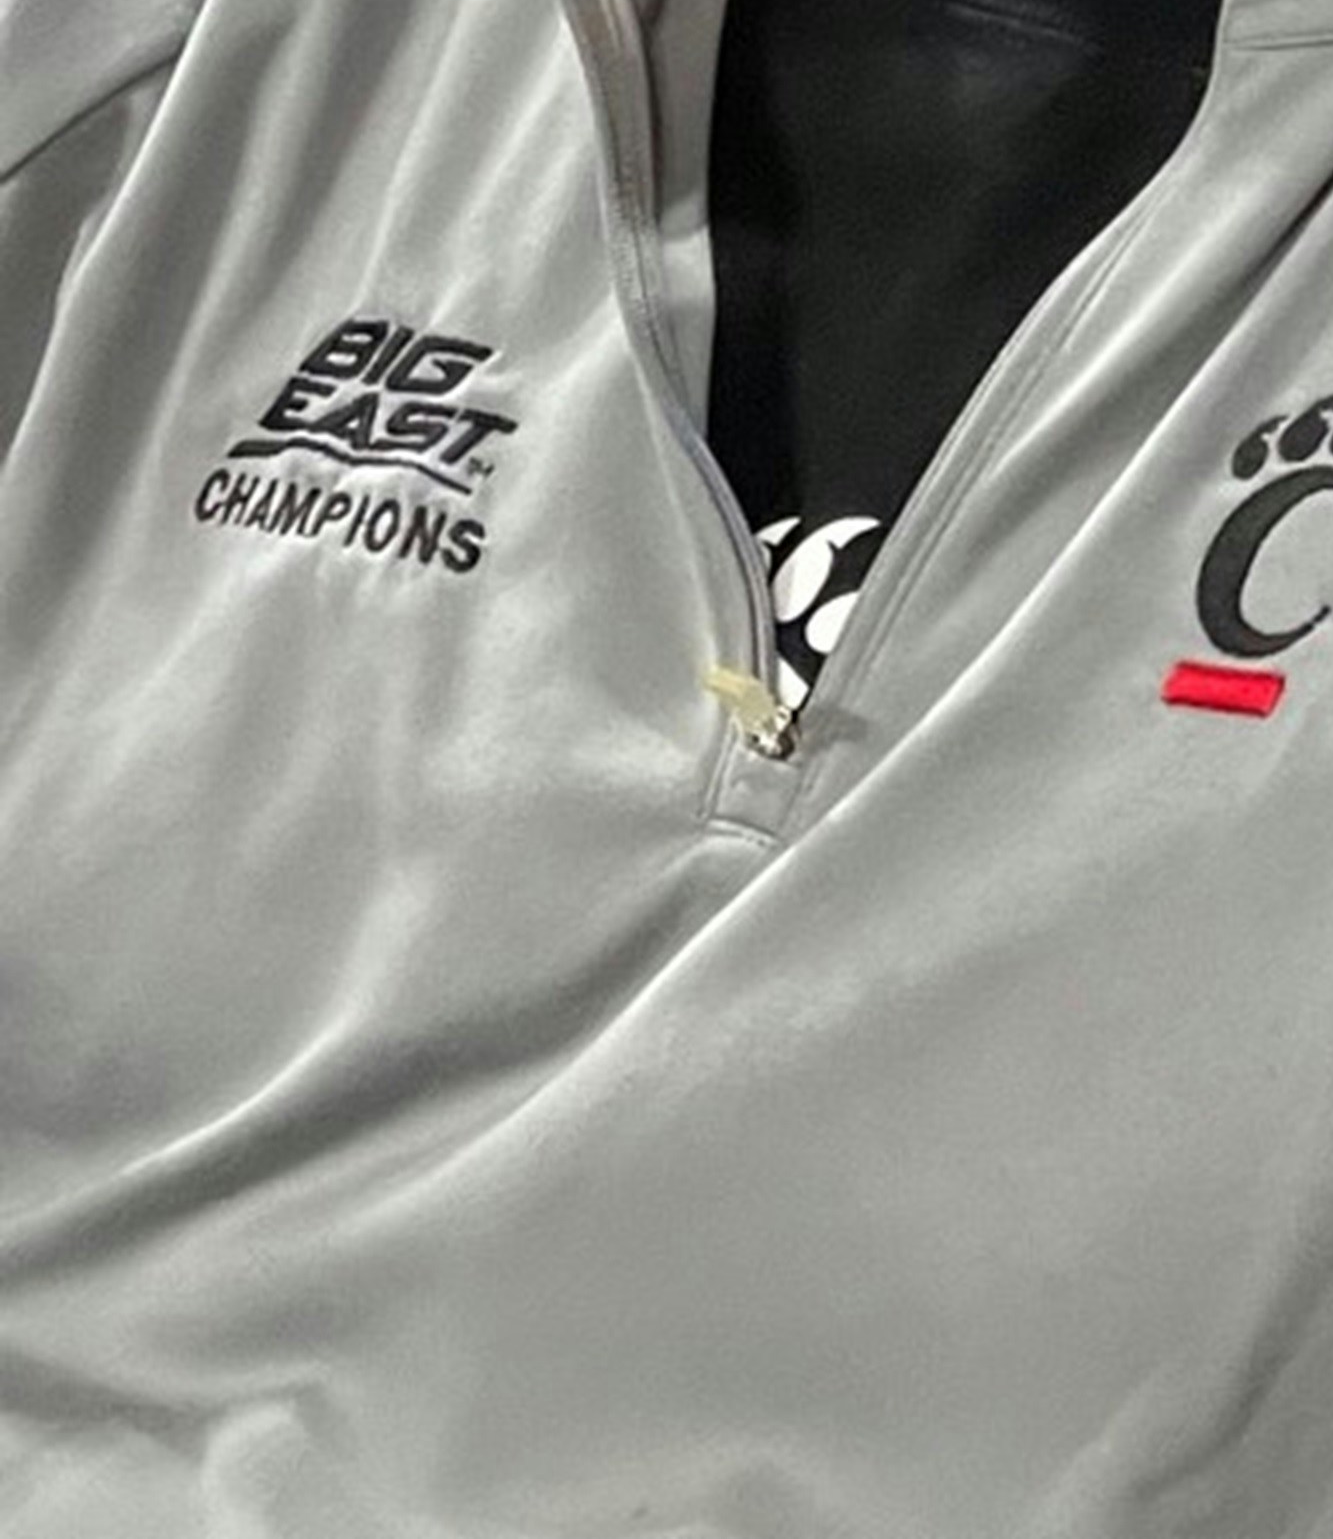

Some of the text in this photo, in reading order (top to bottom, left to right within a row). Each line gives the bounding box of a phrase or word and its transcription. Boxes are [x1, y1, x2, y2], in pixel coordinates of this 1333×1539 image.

[298, 319, 494, 396] BIG
[257, 375, 518, 464] EAST
[194, 468, 487, 573] CHAMPIONS
